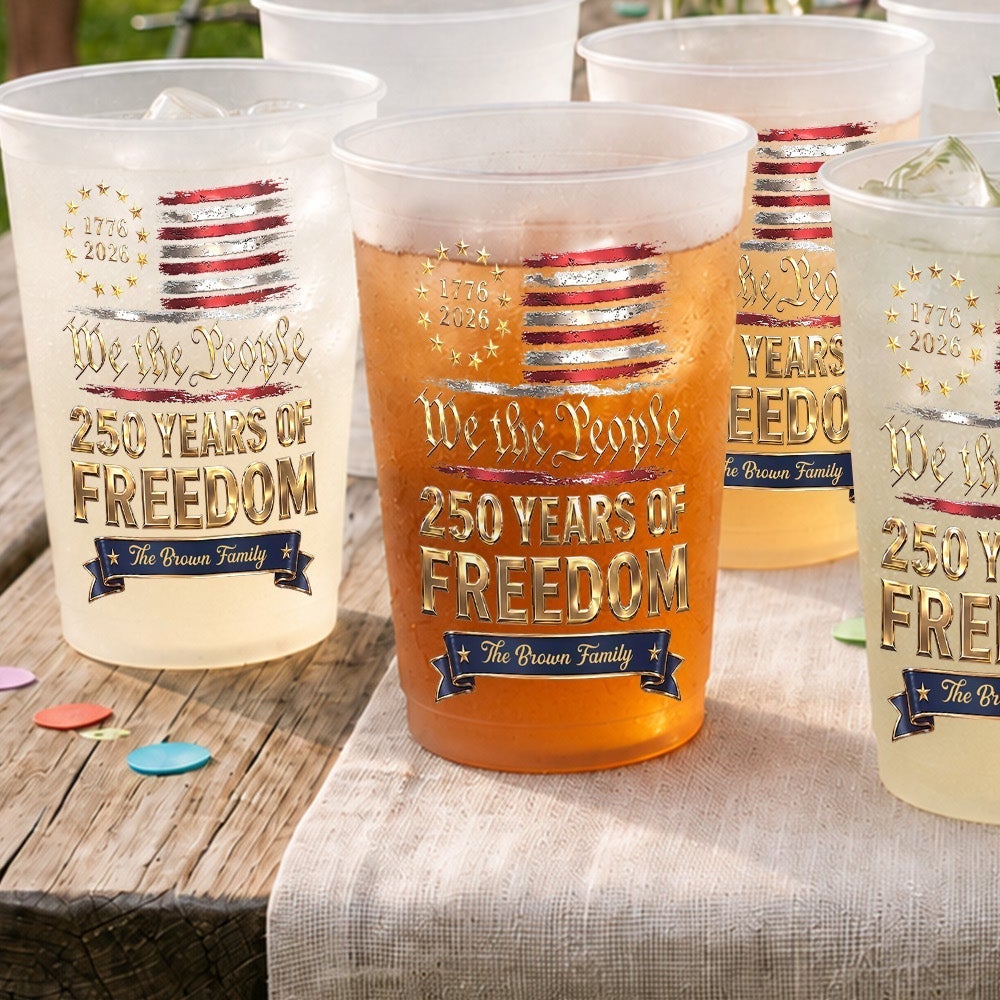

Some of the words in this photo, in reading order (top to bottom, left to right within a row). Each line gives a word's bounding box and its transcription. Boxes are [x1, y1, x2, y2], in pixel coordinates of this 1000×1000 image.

[84, 216, 128, 237] 1776
[84, 241, 130, 263] 2026
[439, 279, 489, 302] 1776
[737, 254, 777, 310] he
[776, 252, 839, 312] Peo
[439, 305, 490, 330] 2026
[910, 302, 962, 328] 1776
[63, 317, 128, 382] We
[132, 326, 189, 385] the
[189, 316, 312, 387] People
[740, 334, 845, 378] YEARS
[909, 330, 961, 357] 2026
[70, 405, 147, 458] 250
[152, 406, 267, 458] YEARS
[276, 399, 312, 447] OF
[414, 388, 485, 461] We
[490, 401, 551, 465] the
[552, 393, 687, 470] People
[727, 385, 850, 445] EEDO
[724, 457, 738, 477] he
[742, 461, 790, 480] Brown
[795, 461, 843, 485] Family
[880, 415, 953, 492] We
[71, 452, 318, 529] FREEDOM
[419, 486, 503, 545] 250
[510, 492, 636, 545] YEARS
[647, 484, 686, 537] OF
[129, 544, 156, 565] The
[159, 547, 211, 566] Brown
[216, 545, 267, 569] Family
[881, 516, 969, 581] 250
[420, 543, 690, 624] FREEDOM
[481, 640, 511, 664] The
[515, 644, 571, 665] Brown
[576, 643, 633, 670] Family
[941, 679, 971, 703] The
